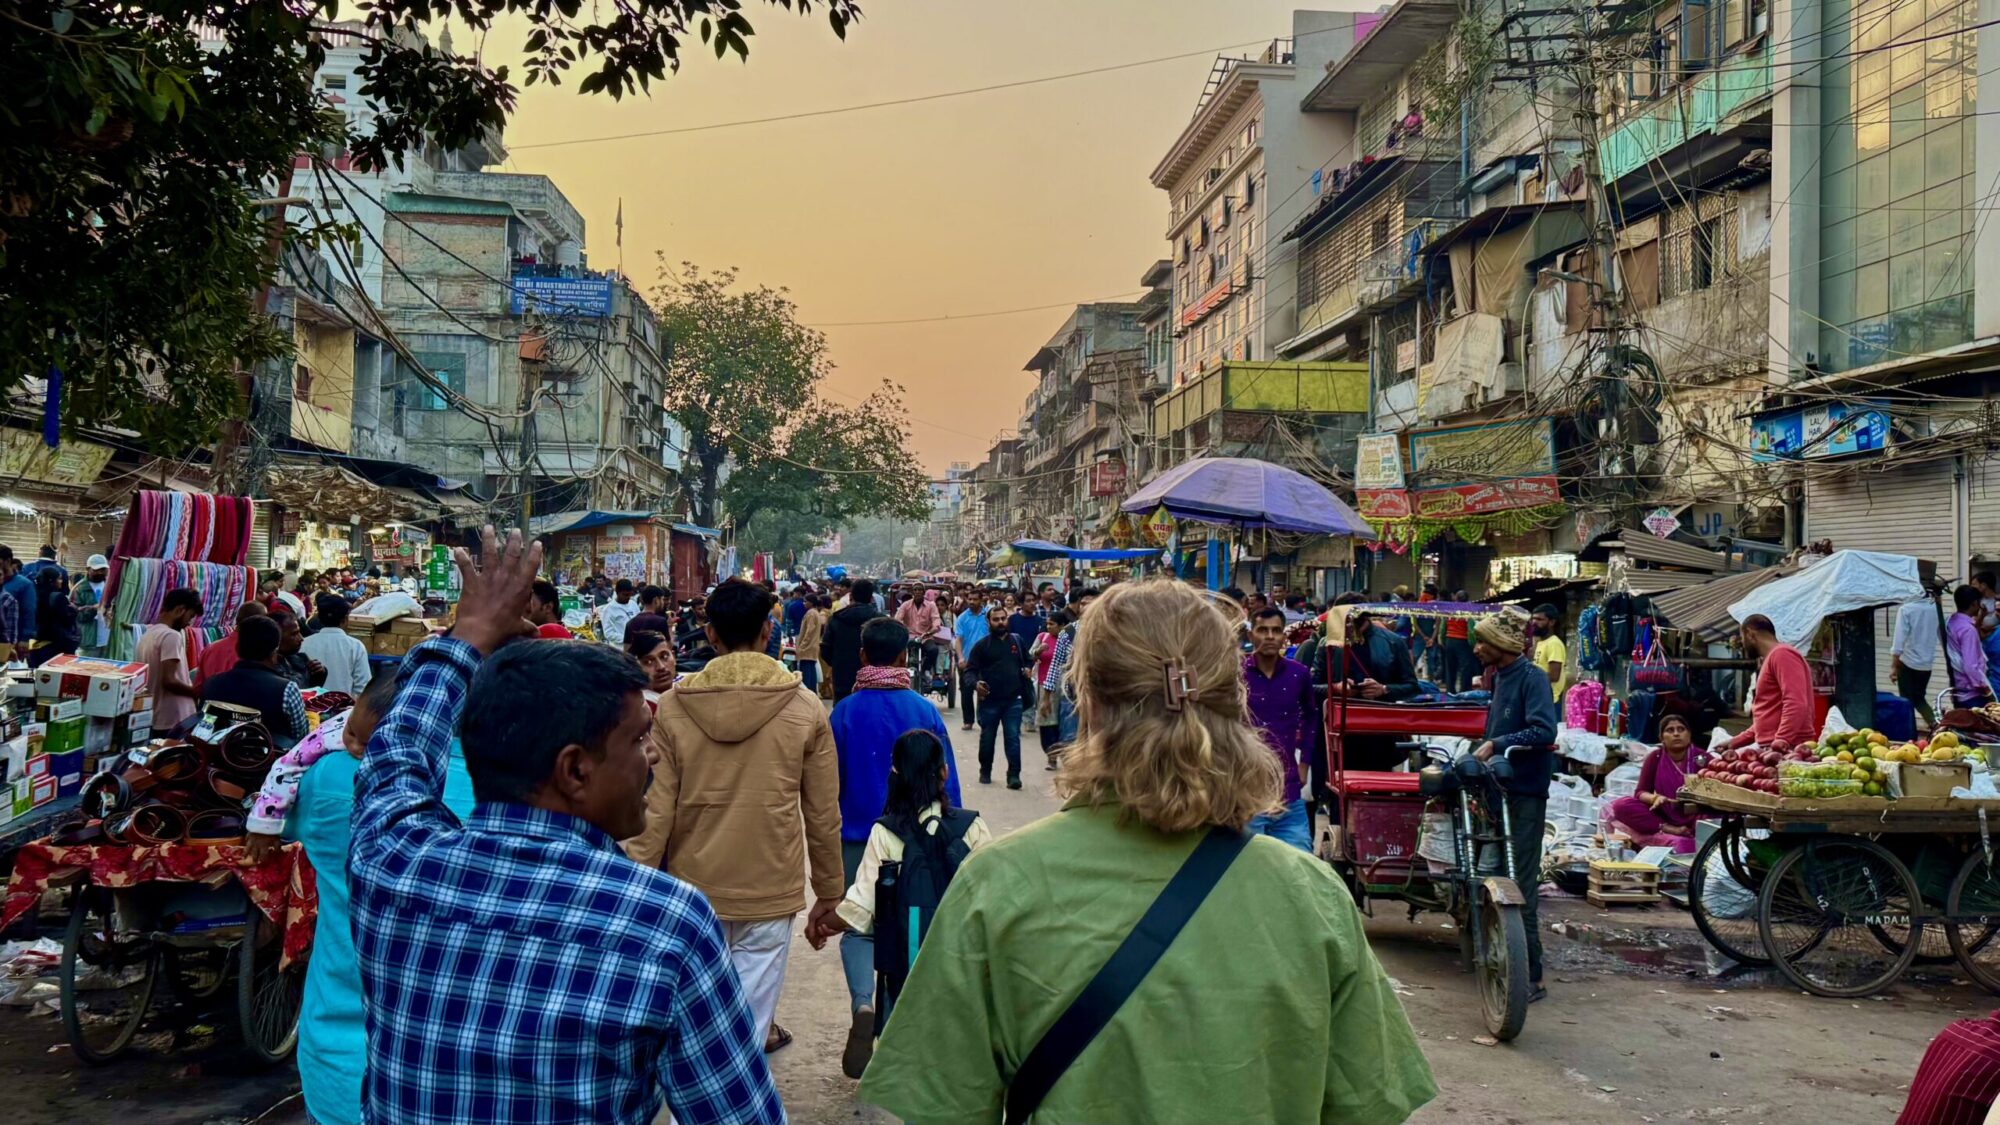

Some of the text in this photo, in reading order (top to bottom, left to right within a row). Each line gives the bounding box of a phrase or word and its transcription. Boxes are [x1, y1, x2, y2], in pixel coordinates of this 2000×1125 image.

[515, 280, 534, 288] DELHI
[536, 281, 580, 290] REGISTRATION
[581, 283, 608, 291] SERVICE
[1810, 418, 1821, 426] LAL
[1864, 915, 1910, 925] MADAM
